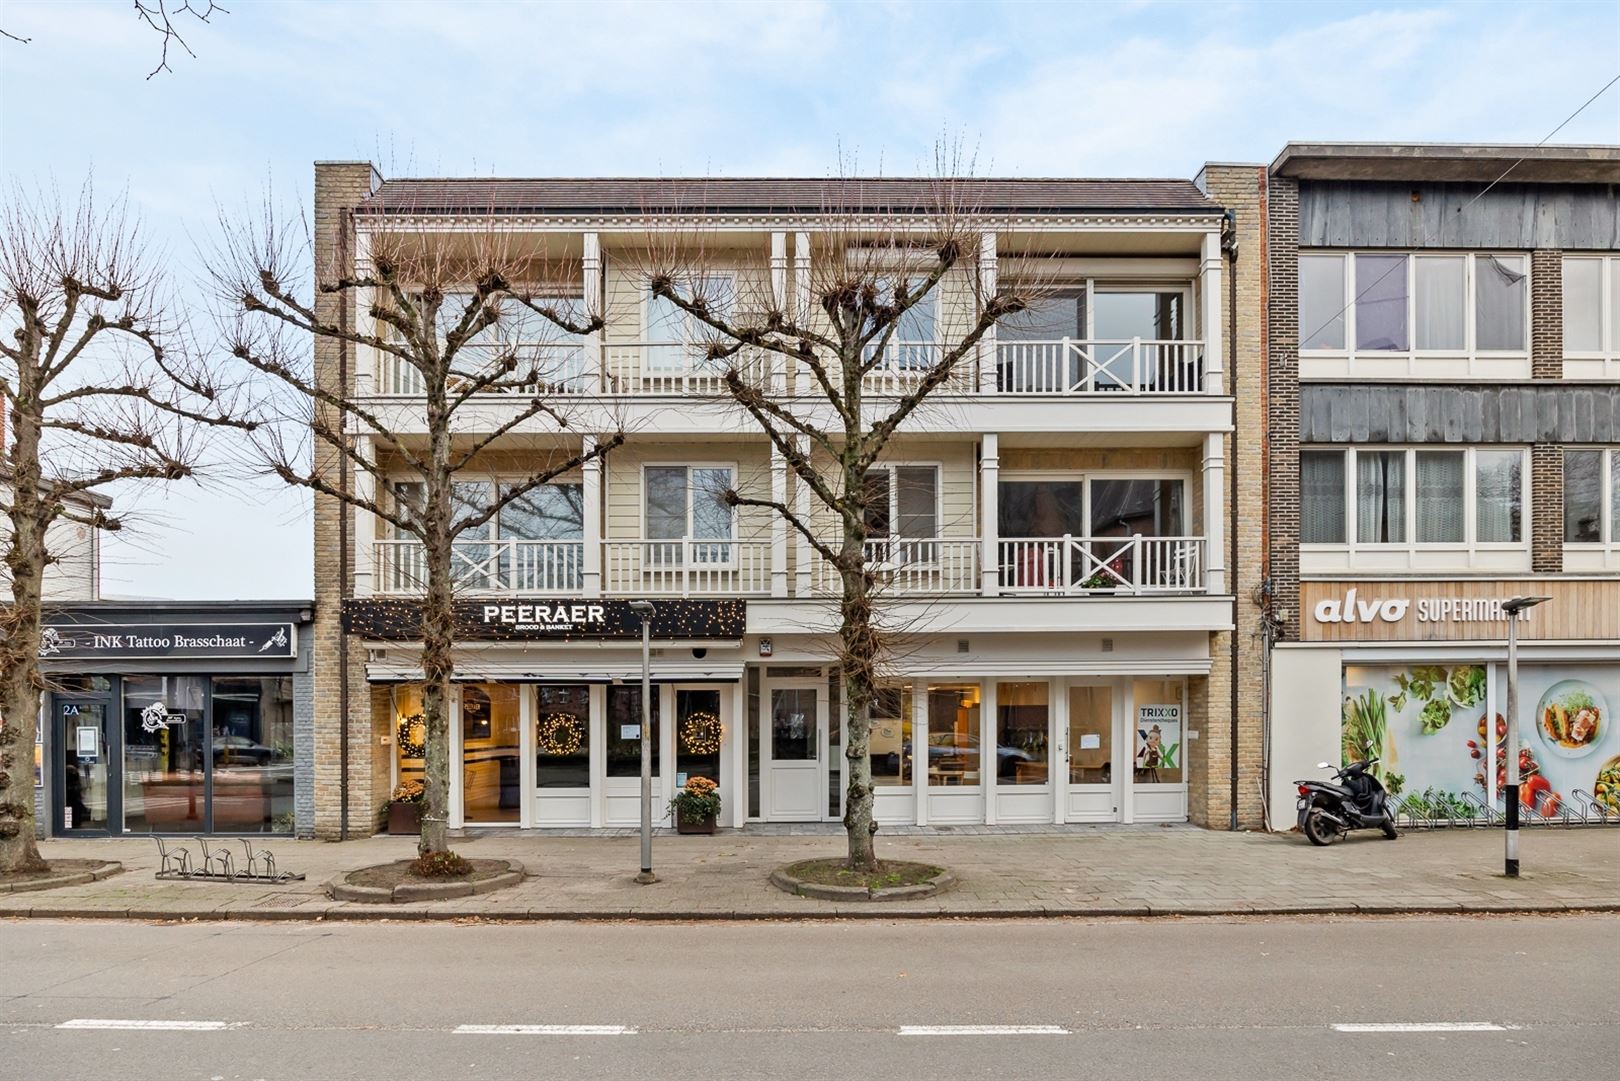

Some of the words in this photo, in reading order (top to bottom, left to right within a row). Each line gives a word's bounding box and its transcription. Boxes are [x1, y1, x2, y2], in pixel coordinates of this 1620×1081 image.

[1314, 587, 1410, 623] alvo
[1418, 599, 1531, 622] SUPERMAR
[483, 605, 605, 623] PEERAER
[93, 635, 123, 648] INK
[126, 635, 170, 648] Tattoo
[174, 634, 246, 648] Brasschaat
[63, 705, 80, 716] 2A
[1140, 707, 1178, 717] TRIXXO
